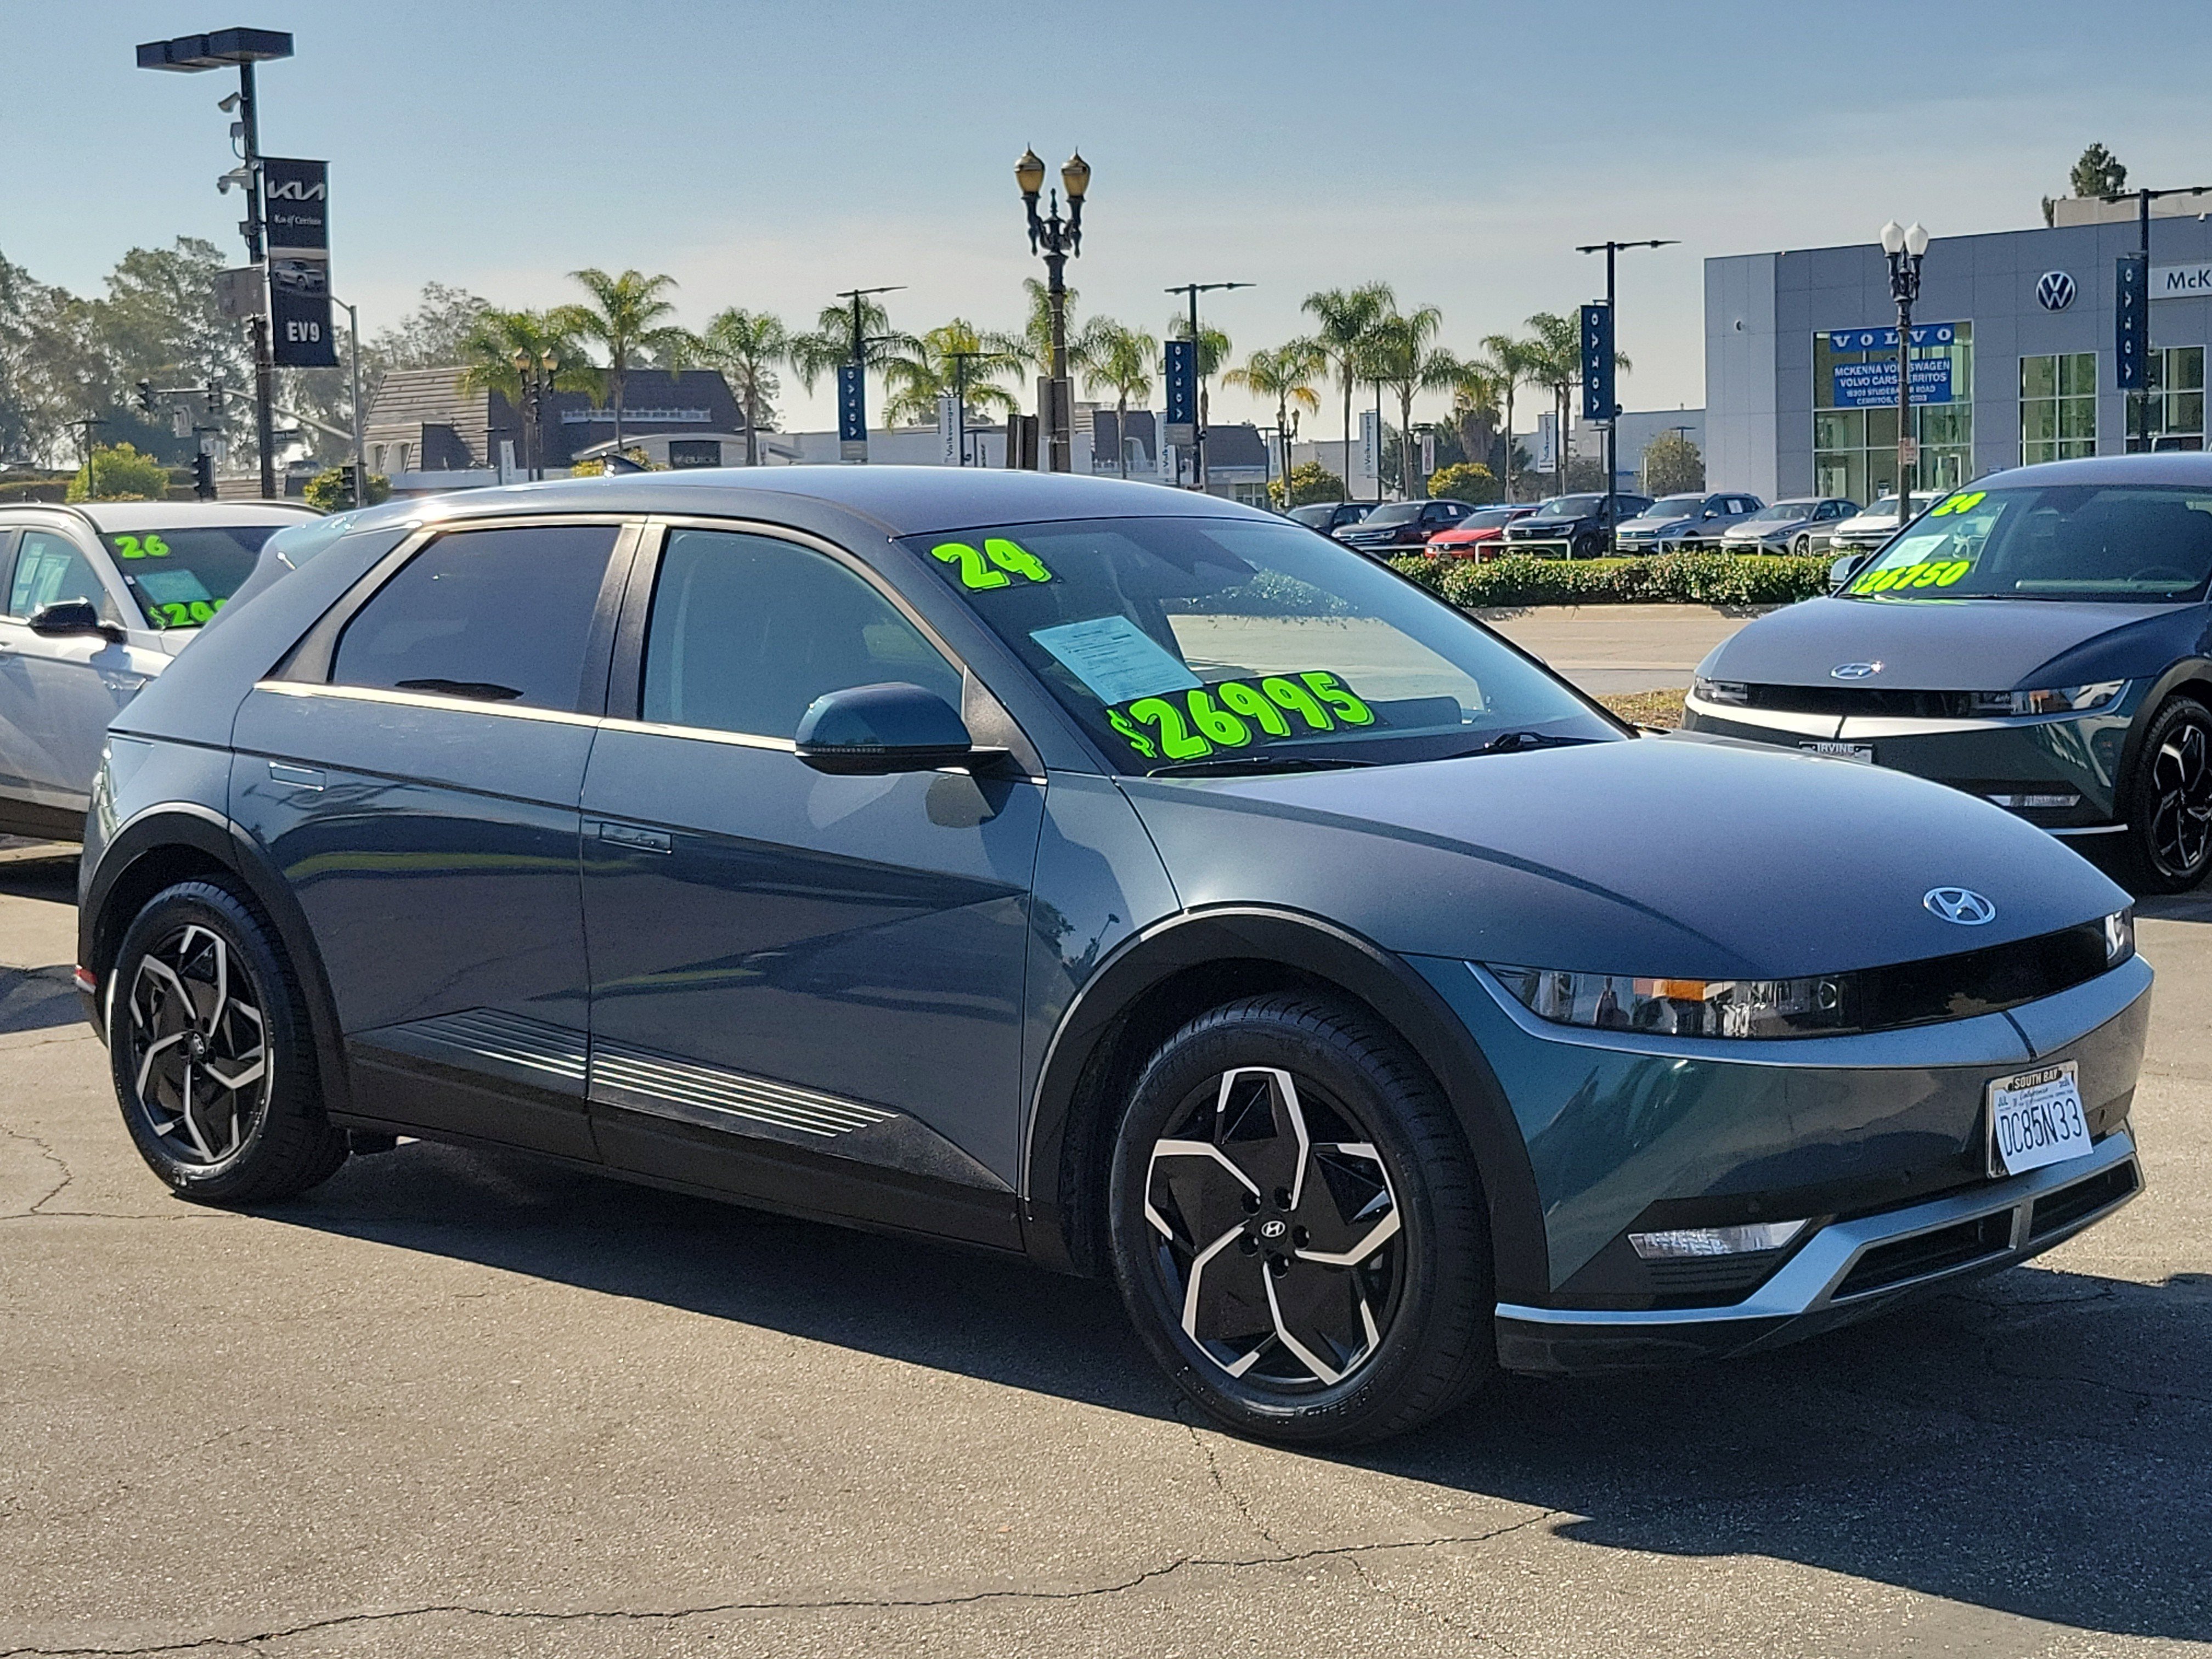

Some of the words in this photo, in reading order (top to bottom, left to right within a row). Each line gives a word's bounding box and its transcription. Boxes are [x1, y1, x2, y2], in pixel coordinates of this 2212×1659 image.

[267, 180, 326, 201] KIA
[287, 321, 319, 341] EV9
[1832, 328, 1951, 348] VOLVO
[1835, 364, 1882, 377] MCKENNA
[1840, 377, 1870, 387] VOLVO
[1872, 375, 1898, 385] CARS
[1931, 492, 1987, 517] 24
[114, 534, 172, 560] 26
[931, 539, 1052, 591] 24
[1107, 670, 1375, 761] $26995
[1817, 743, 1855, 753] IRVINE
[2014, 1073, 2041, 1090] SOUTH
[2043, 1068, 2058, 1082] BAY
[2000, 1097, 2082, 1156] DC85N33
